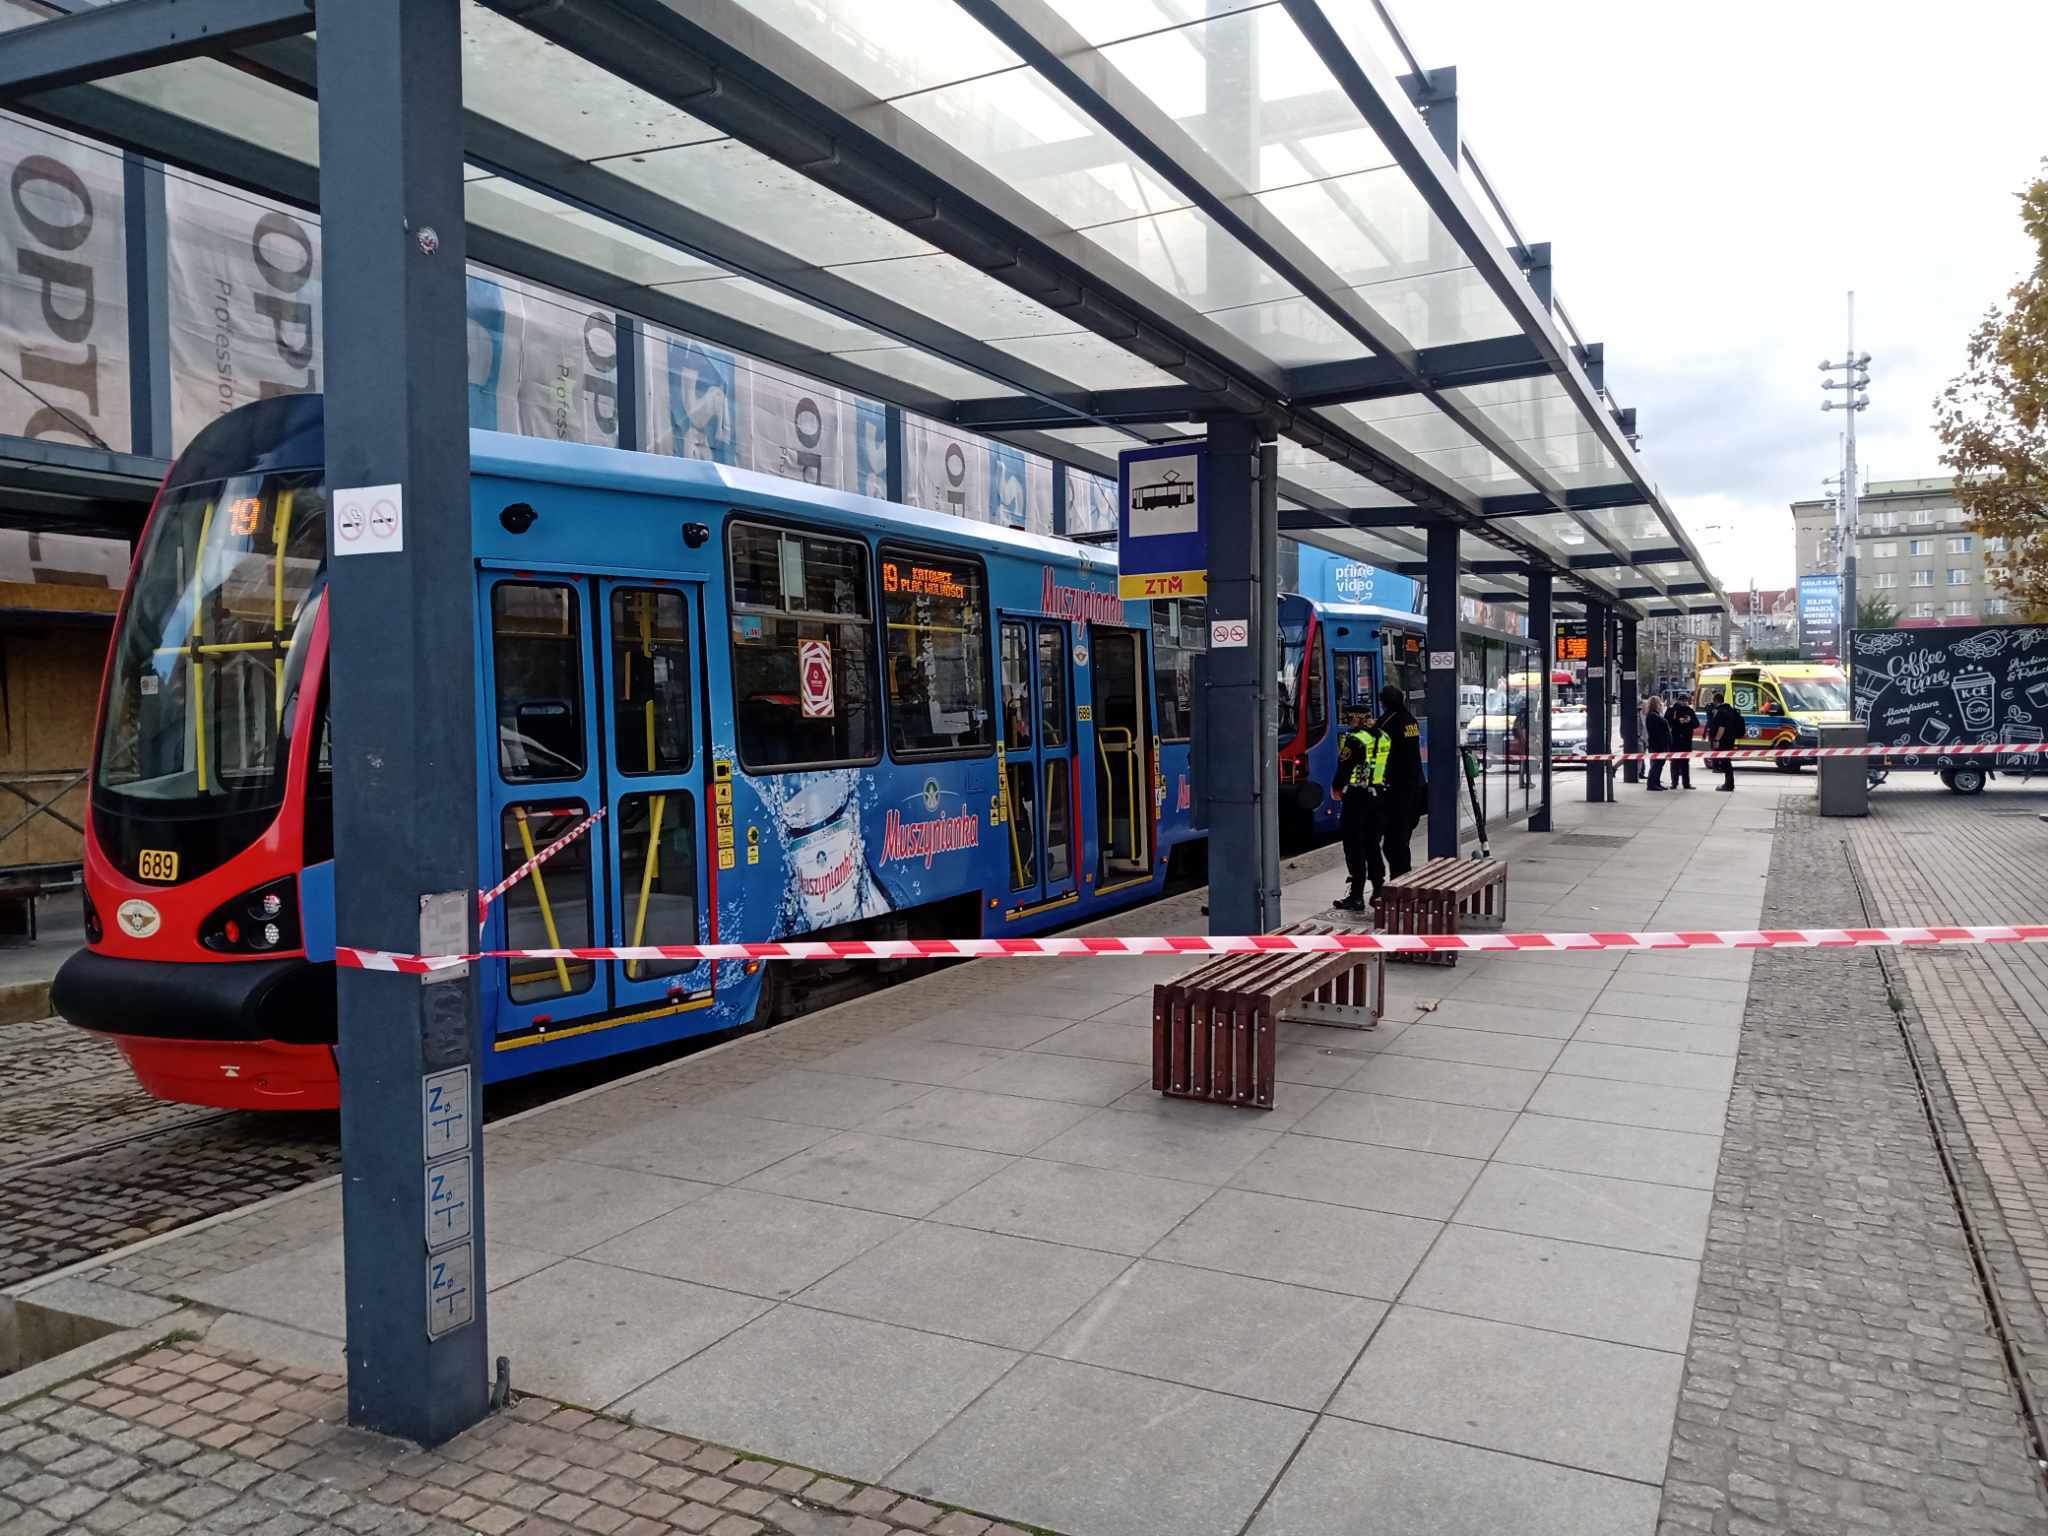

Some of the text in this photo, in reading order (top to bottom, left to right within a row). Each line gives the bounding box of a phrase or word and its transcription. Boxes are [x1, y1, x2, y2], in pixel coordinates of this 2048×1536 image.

[1335, 563, 1375, 581] prime
[1336, 578, 1374, 592] video
[1145, 576, 1184, 596] ZTM
[1887, 648, 1946, 677] Coffee
[1895, 669, 1951, 696] Time
[879, 799, 979, 870] Muszynianka
[142, 851, 174, 879] 689
